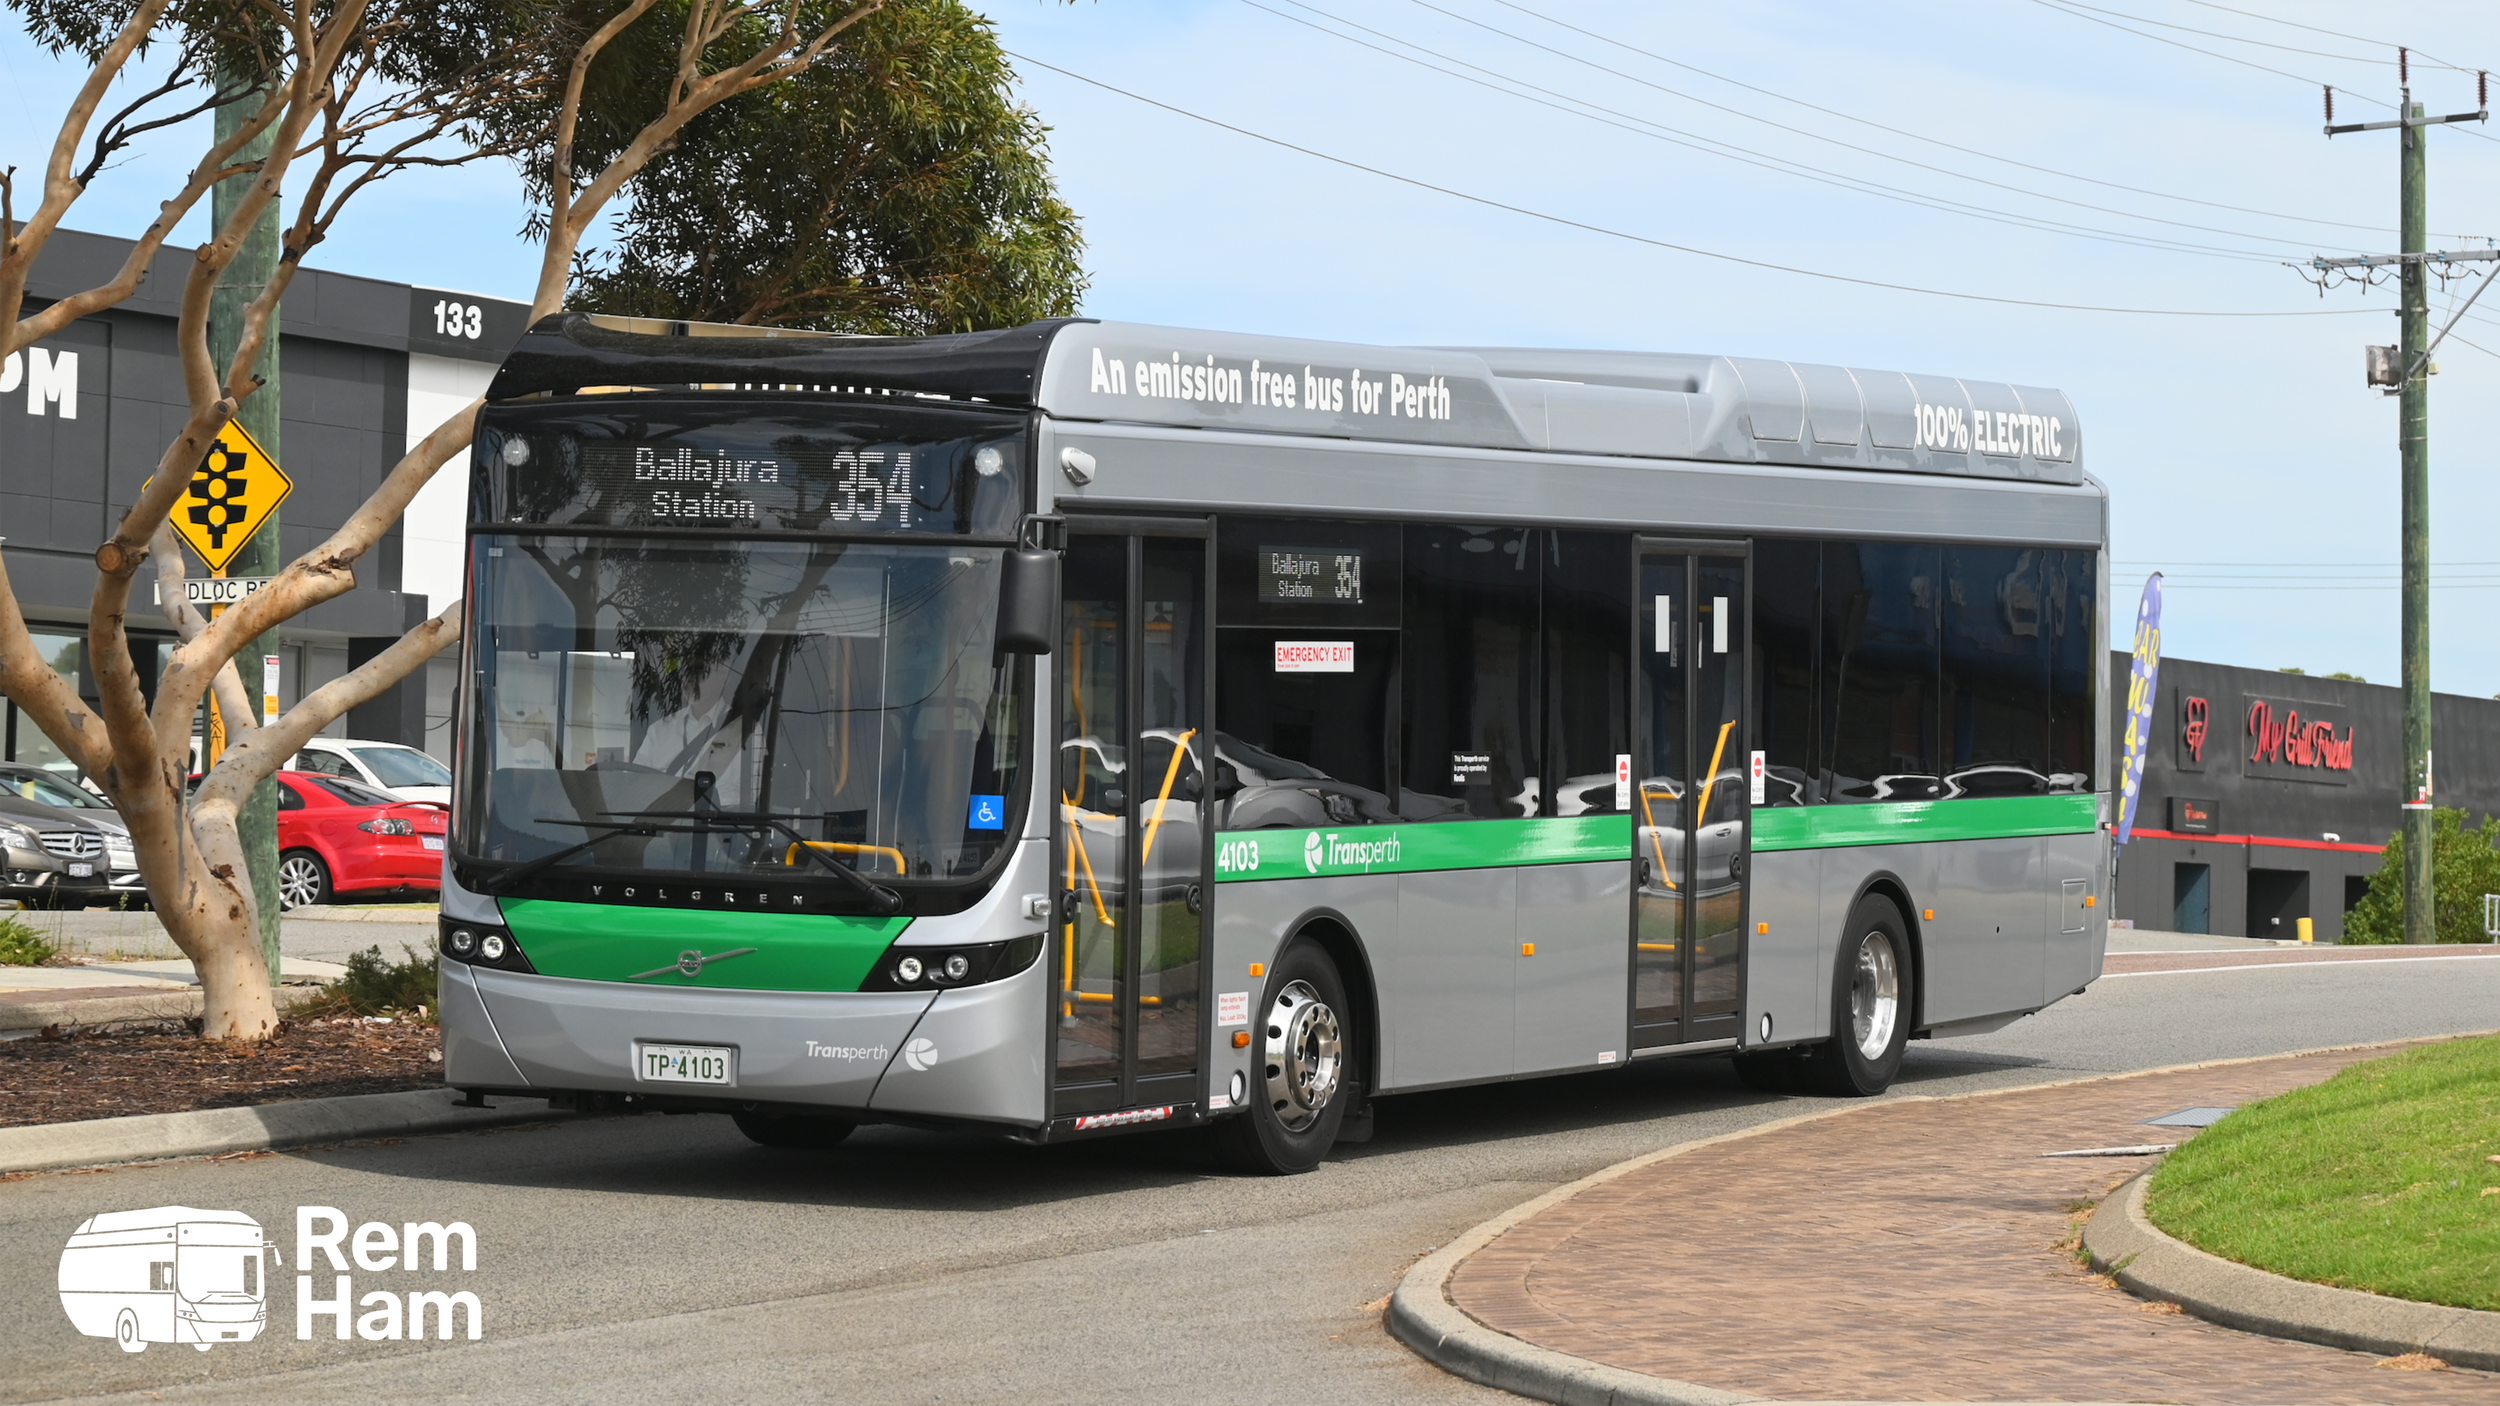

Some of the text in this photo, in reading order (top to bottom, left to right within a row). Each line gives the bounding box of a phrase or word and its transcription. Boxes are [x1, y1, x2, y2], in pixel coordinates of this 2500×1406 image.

[433, 300, 483, 340] 133
[1091, 347, 1451, 420] An emission free bus for Perth
[1914, 403, 2062, 458] 100% ELECTRIC
[634, 446, 778, 489] Ballajura
[830, 451, 913, 523] 354
[652, 491, 755, 520] Station
[1271, 552, 1320, 579] Ballajura
[1334, 555, 1361, 599] 354
[1278, 578, 1314, 599] Station
[1277, 647, 1352, 662] EMERGENCY EXIT
[2247, 700, 2354, 770] My Grill Friend
[1218, 840, 1259, 872] 4103
[1326, 832, 1401, 873] Transperth
[593, 885, 803, 906] VOLGREN
[679, 1048, 692, 1056] WA
[805, 1040, 889, 1063] Transperth
